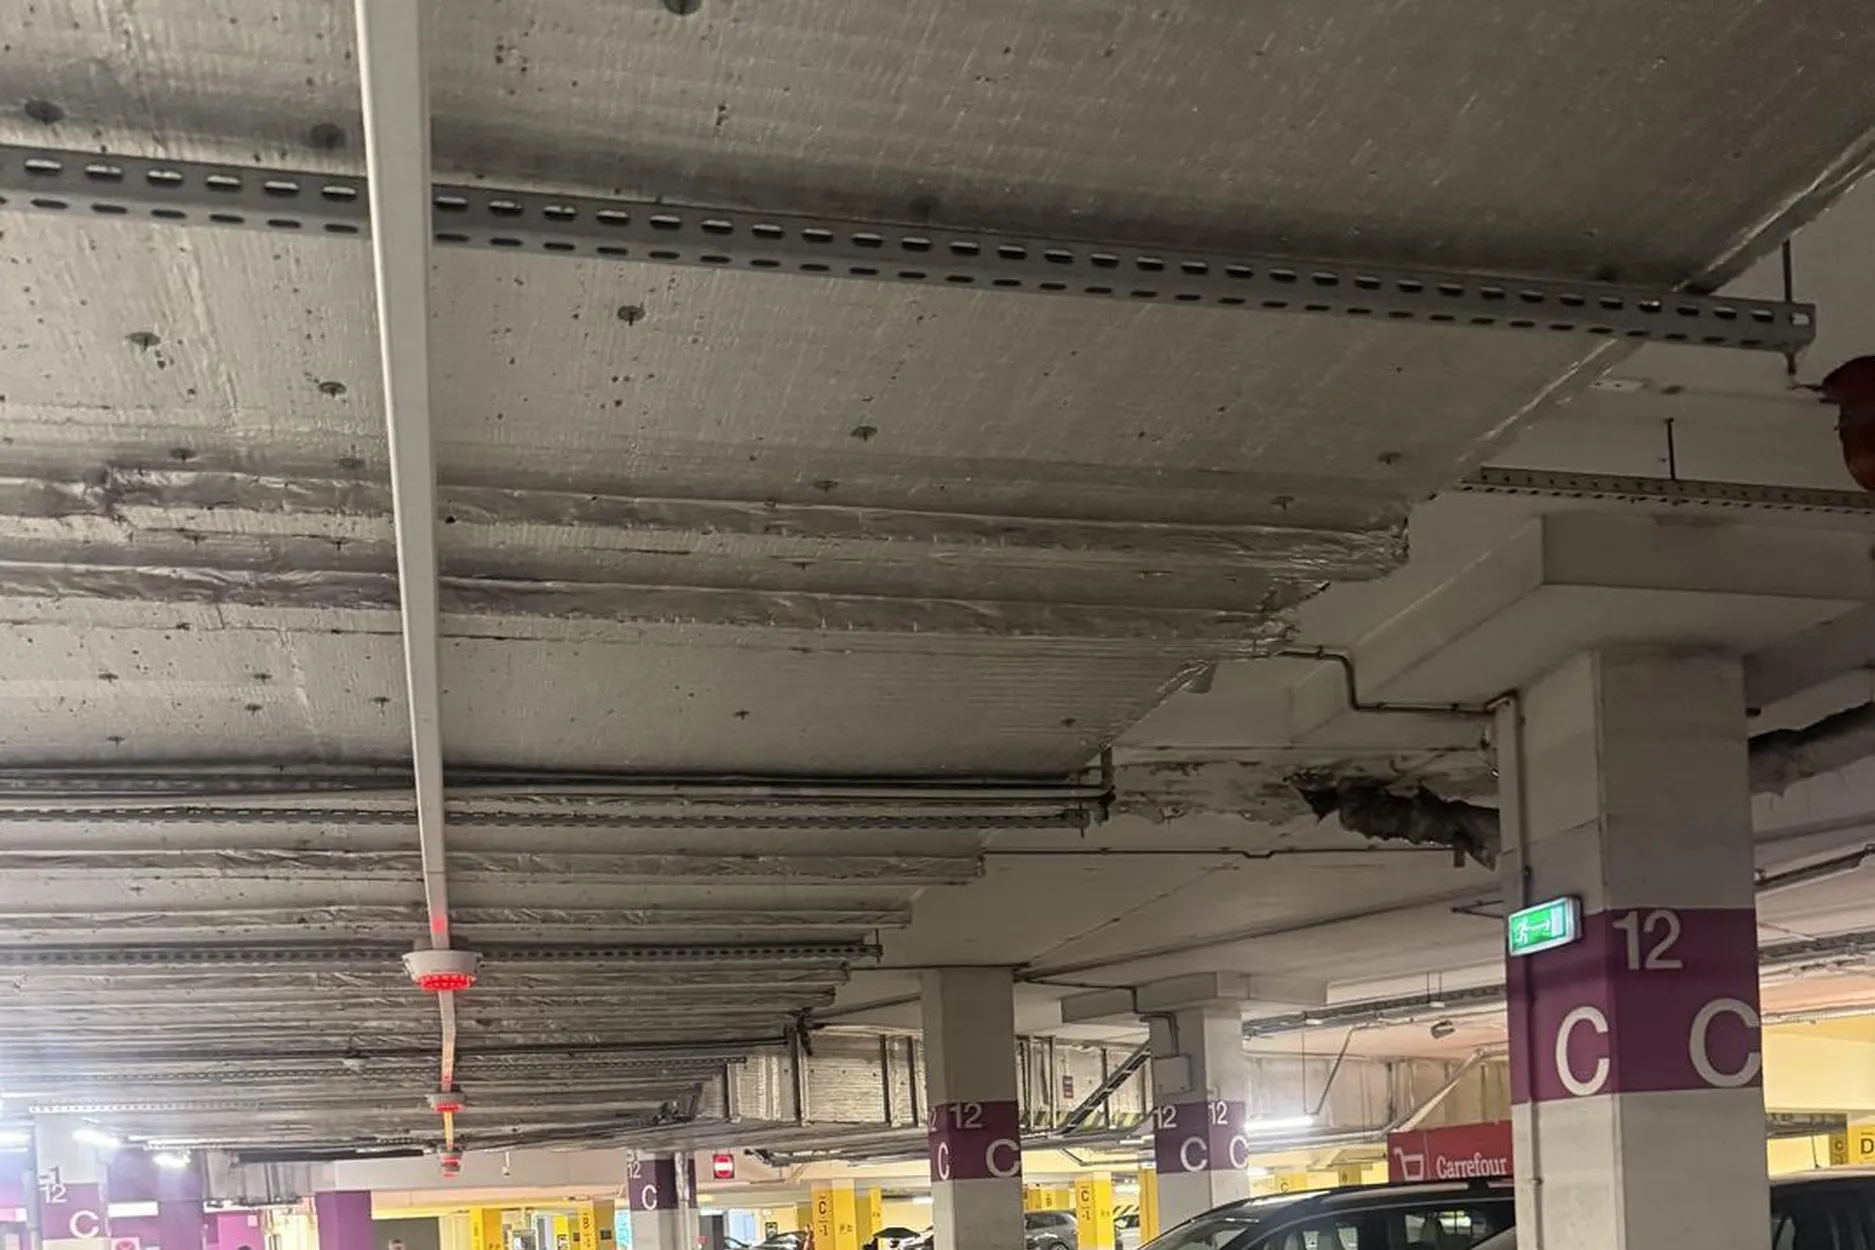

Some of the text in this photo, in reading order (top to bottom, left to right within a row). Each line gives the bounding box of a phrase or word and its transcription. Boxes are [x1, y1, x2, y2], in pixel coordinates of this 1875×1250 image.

[1612, 909, 1683, 970] 12
[1555, 1005, 1611, 1097] C
[1689, 997, 1761, 1088] C
[949, 1102, 984, 1129] 12
[1153, 1105, 1177, 1129] 12
[1208, 1101, 1229, 1125] 12
[985, 1138, 1020, 1178] C
[1180, 1136, 1208, 1172] C
[1229, 1134, 1248, 1169] C
[1860, 1138, 1874, 1155] D
[626, 1161, 642, 1179] 12
[938, 1141, 950, 1181] C
[1435, 1151, 1508, 1180] Carrefour
[39, 1183, 68, 1204] 12
[642, 1184, 658, 1212] C
[818, 1200, 828, 1215] C
[1080, 1190, 1090, 1203] C
[69, 1209, 100, 1239] C
